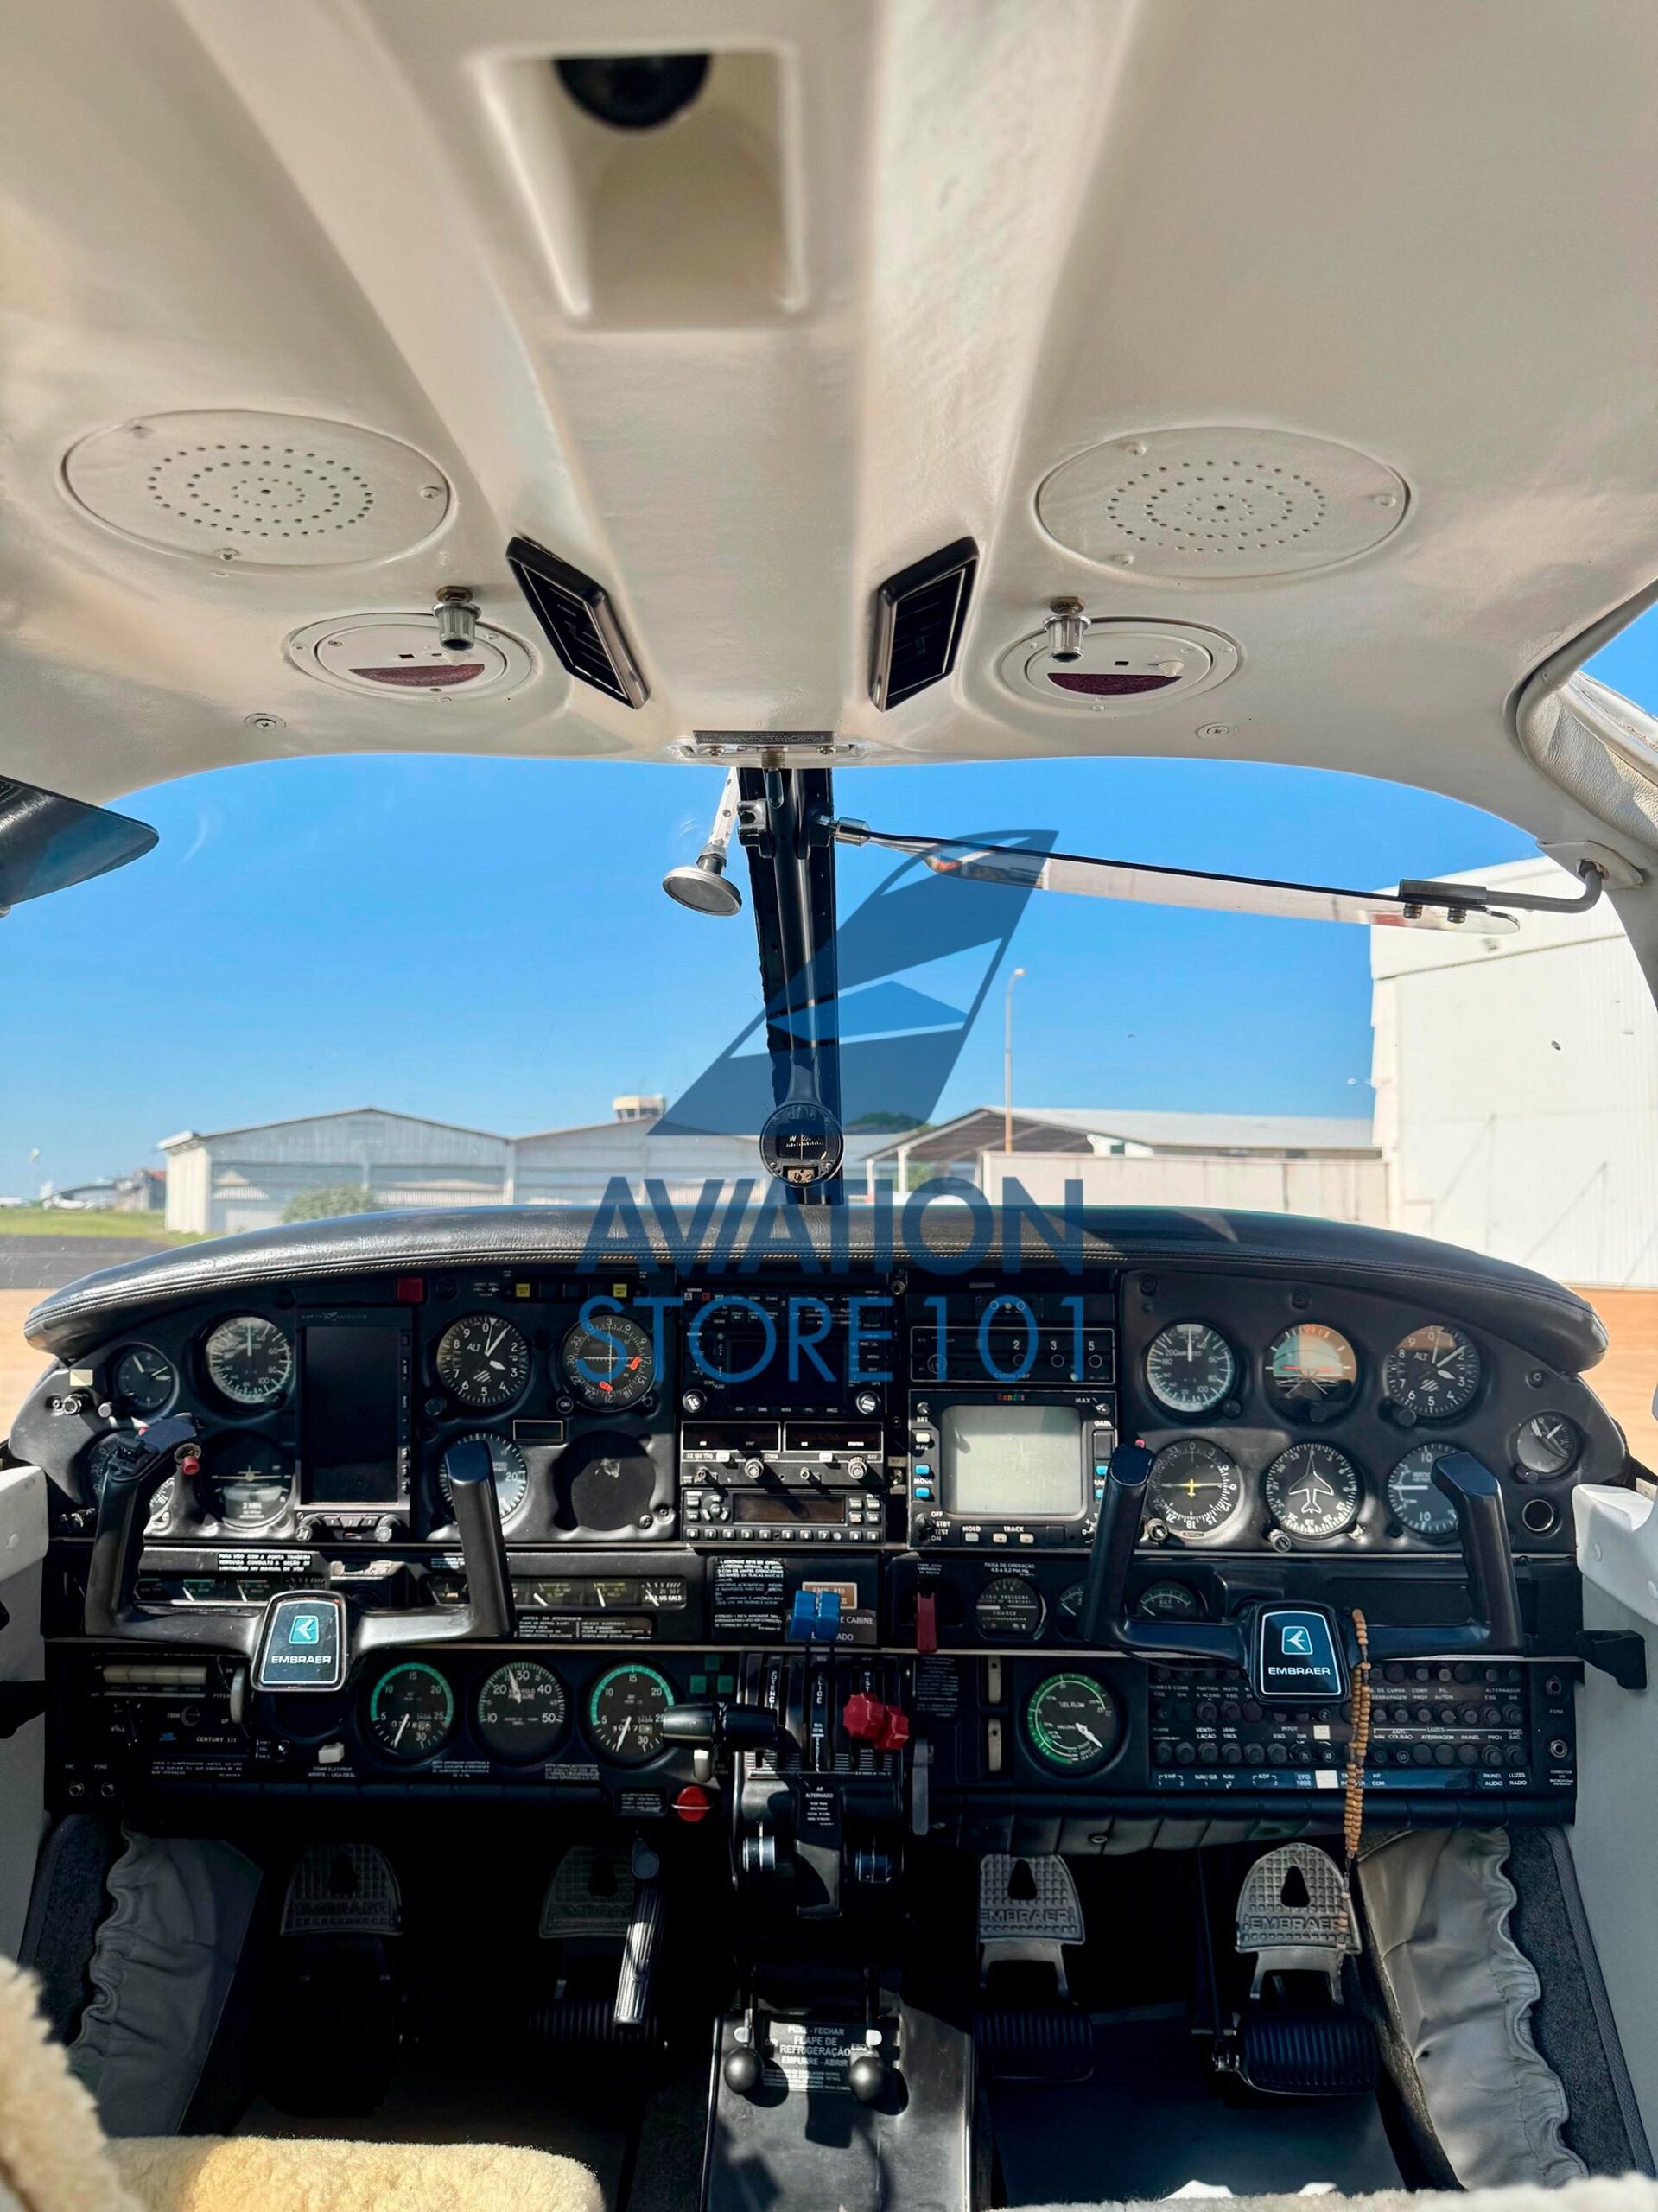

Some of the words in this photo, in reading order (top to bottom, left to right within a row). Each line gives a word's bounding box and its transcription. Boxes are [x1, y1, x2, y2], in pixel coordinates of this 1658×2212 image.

[607, 1318, 613, 1326] 3
[482, 1322, 489, 1333] 0
[463, 1328, 471, 1338] 9
[1428, 1332, 1435, 1342] 0
[454, 1338, 461, 1350] 8
[570, 1336, 581, 1347] 33
[1013, 1340, 1020, 1350] 2
[1050, 1341, 1058, 1351] 3
[1407, 1338, 1416, 1347] 9
[467, 1342, 481, 1352] ALT
[511, 1343, 518, 1352] 2
[1088, 1342, 1096, 1351] 5
[1398, 1349, 1405, 1358] 8
[1413, 1352, 1429, 1362] ALT
[567, 1354, 575, 1365] 30
[644, 1356, 651, 1365] 12
[454, 1369, 460, 1378] 7
[511, 1367, 518, 1376] 3
[461, 1380, 469, 1389] 6
[499, 1382, 507, 1390] 4
[1399, 1379, 1407, 1389] 7
[1458, 1377, 1465, 1387] 3
[480, 1386, 488, 1397] 5
[623, 1389, 634, 1399] 18
[1408, 1390, 1416, 1400] 6
[1446, 1390, 1454, 1399] 4
[604, 1395, 613, 1403] 21
[1428, 1396, 1435, 1406] 5
[1421, 1453, 1433, 1463] 10
[505, 1472, 518, 1481] 20
[1206, 1516, 1217, 1525] 15
[1420, 1512, 1432, 1521] 10
[1185, 1520, 1197, 1529] 18
[846, 1615, 873, 1625] CABINE
[270, 1655, 332, 1664] EMBRAER
[1267, 1666, 1331, 1675] EMBRAER
[409, 1671, 417, 1680] 15
[516, 1670, 530, 1681] 30
[629, 1674, 638, 1682] 15
[385, 1685, 394, 1694] 10
[430, 1685, 441, 1694] 20
[492, 1684, 507, 1694] 20
[537, 1684, 552, 1694] 40
[605, 1688, 614, 1696] 10
[651, 1688, 663, 1696] 20
[380, 1712, 387, 1720] 5
[434, 1712, 444, 1720] 25
[486, 1713, 498, 1723] 10
[542, 1713, 556, 1723] 50
[601, 1715, 607, 1724] 5
[416, 1732, 427, 1741] 30
[638, 1736, 649, 1745] 30
[814, 2027, 845, 2036] FECHAR
[794, 2036, 823, 2045] FLAPE
[824, 2037, 838, 2046] DE
[779, 2044, 852, 2056] REFRIGERAÇÃO
[850, 2043, 867, 2051] ESQ
[781, 2056, 819, 2065] EMPURRE
